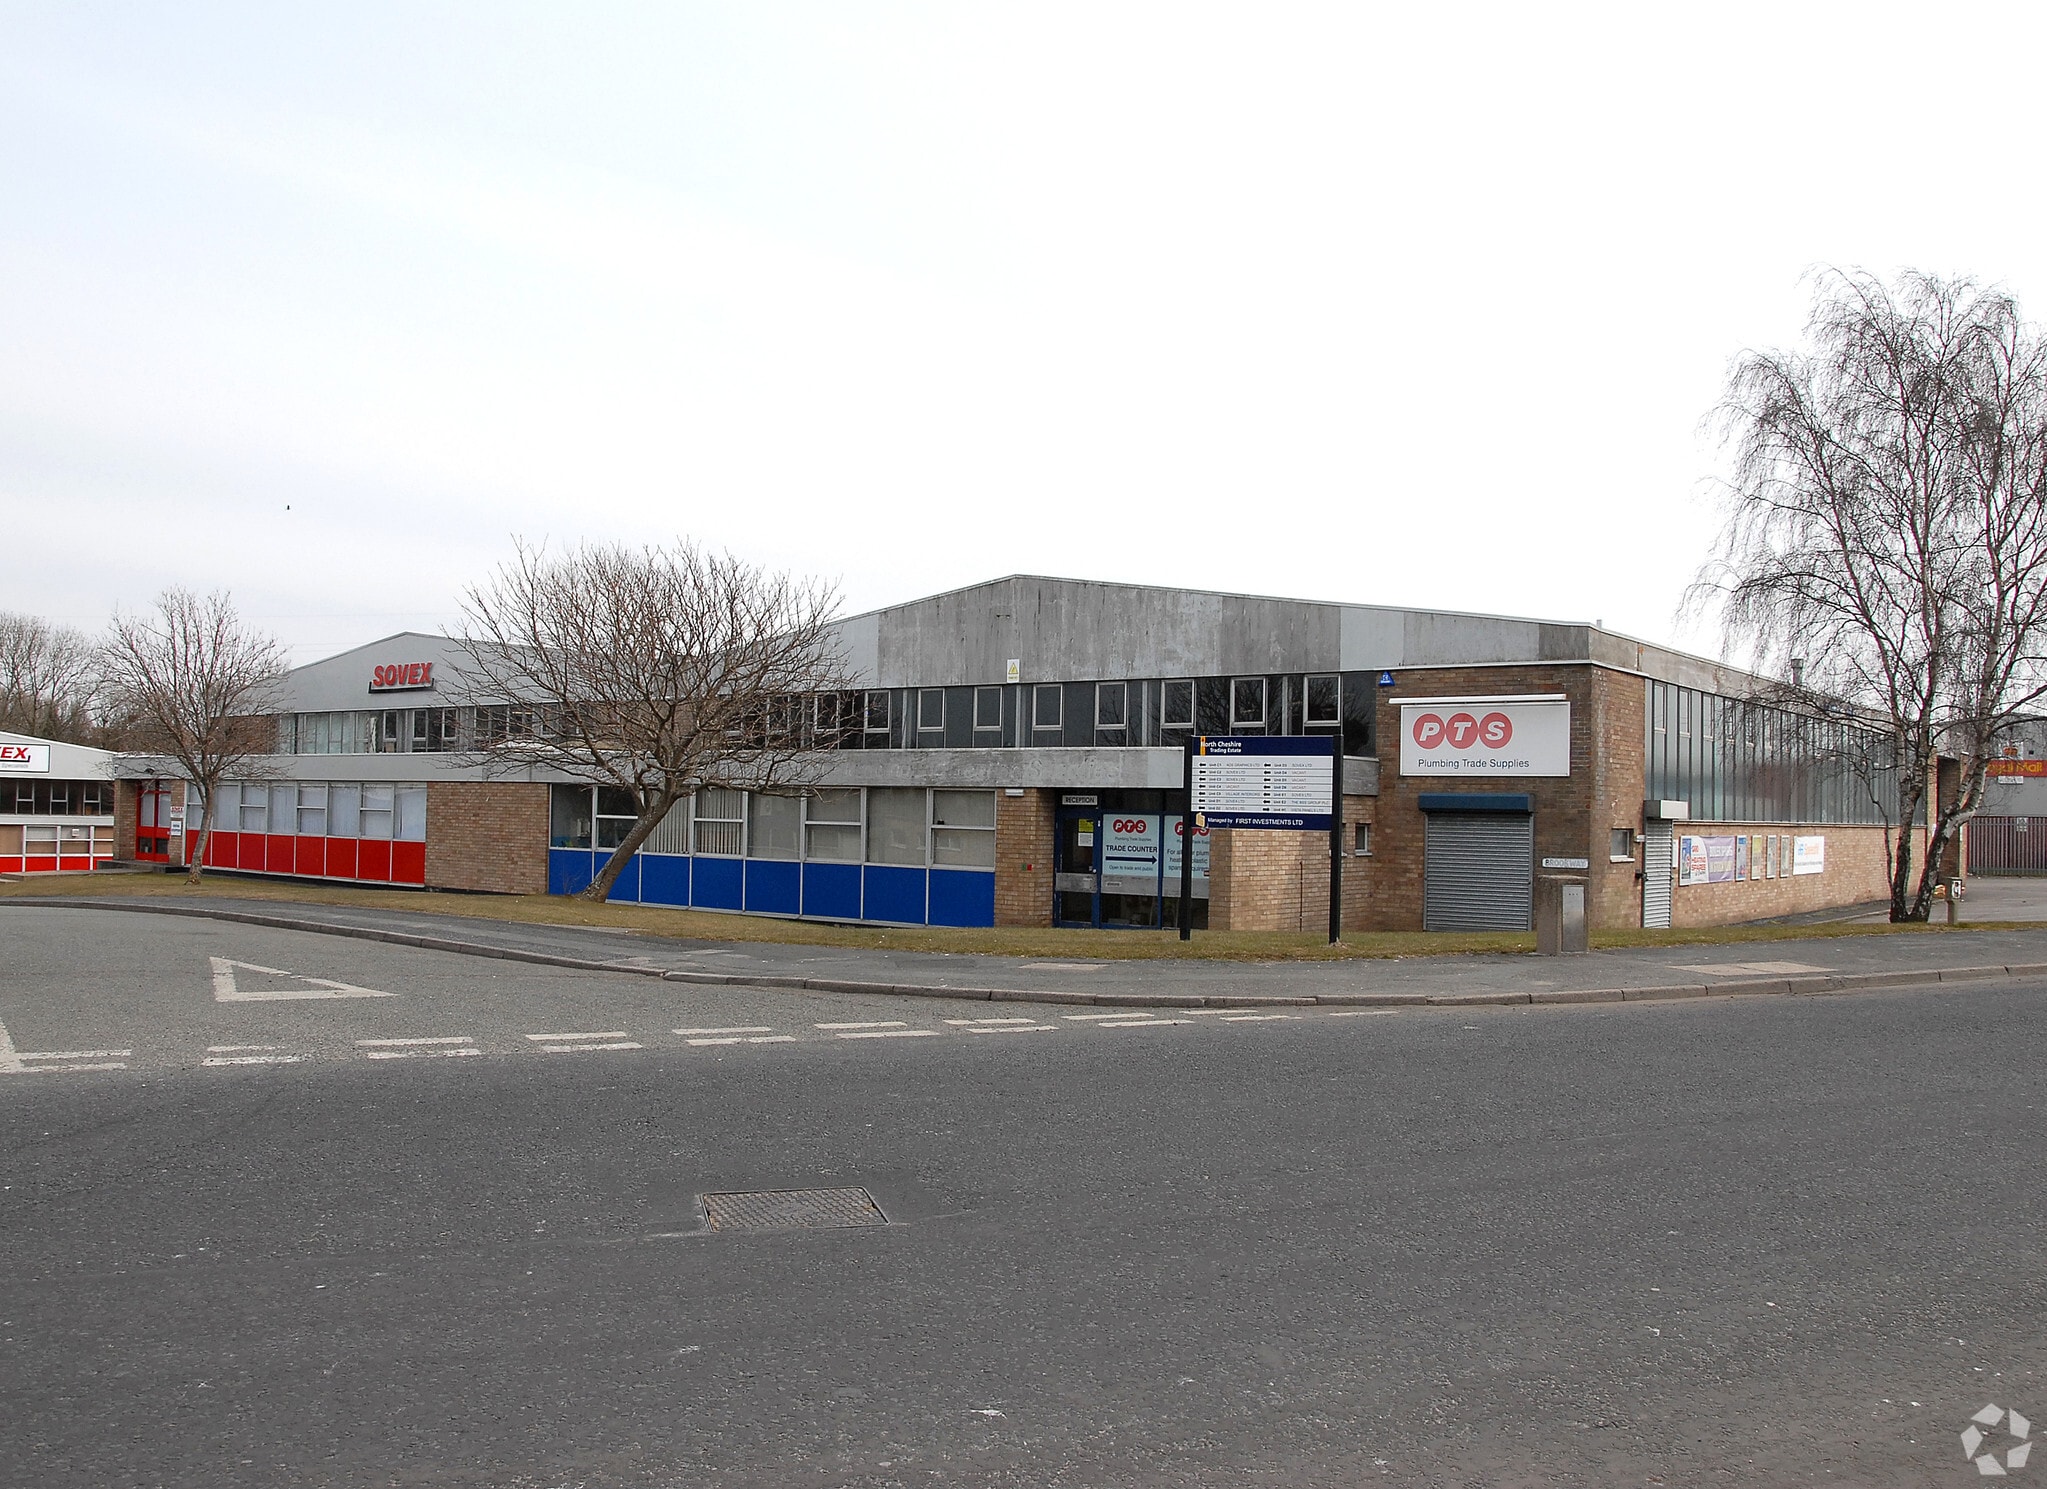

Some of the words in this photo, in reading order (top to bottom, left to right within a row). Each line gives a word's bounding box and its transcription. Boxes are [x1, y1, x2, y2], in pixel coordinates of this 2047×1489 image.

[373, 662, 432, 687] SOVEX
[1419, 720, 1506, 742] PTS
[1217, 740, 1242, 748] Cheshire
[1418, 758, 1460, 770] Plumbing
[1461, 758, 1487, 768] Trade
[1489, 758, 1530, 770] Supplies
[2016, 762, 2043, 773] Mail
[1065, 796, 1095, 804] RECEPTION
[1235, 817, 1252, 825] FIRST
[1252, 818, 1292, 826] INVESTMENTS
[1115, 822, 1145, 831] PTS
[1127, 845, 1158, 853] COUNTER
